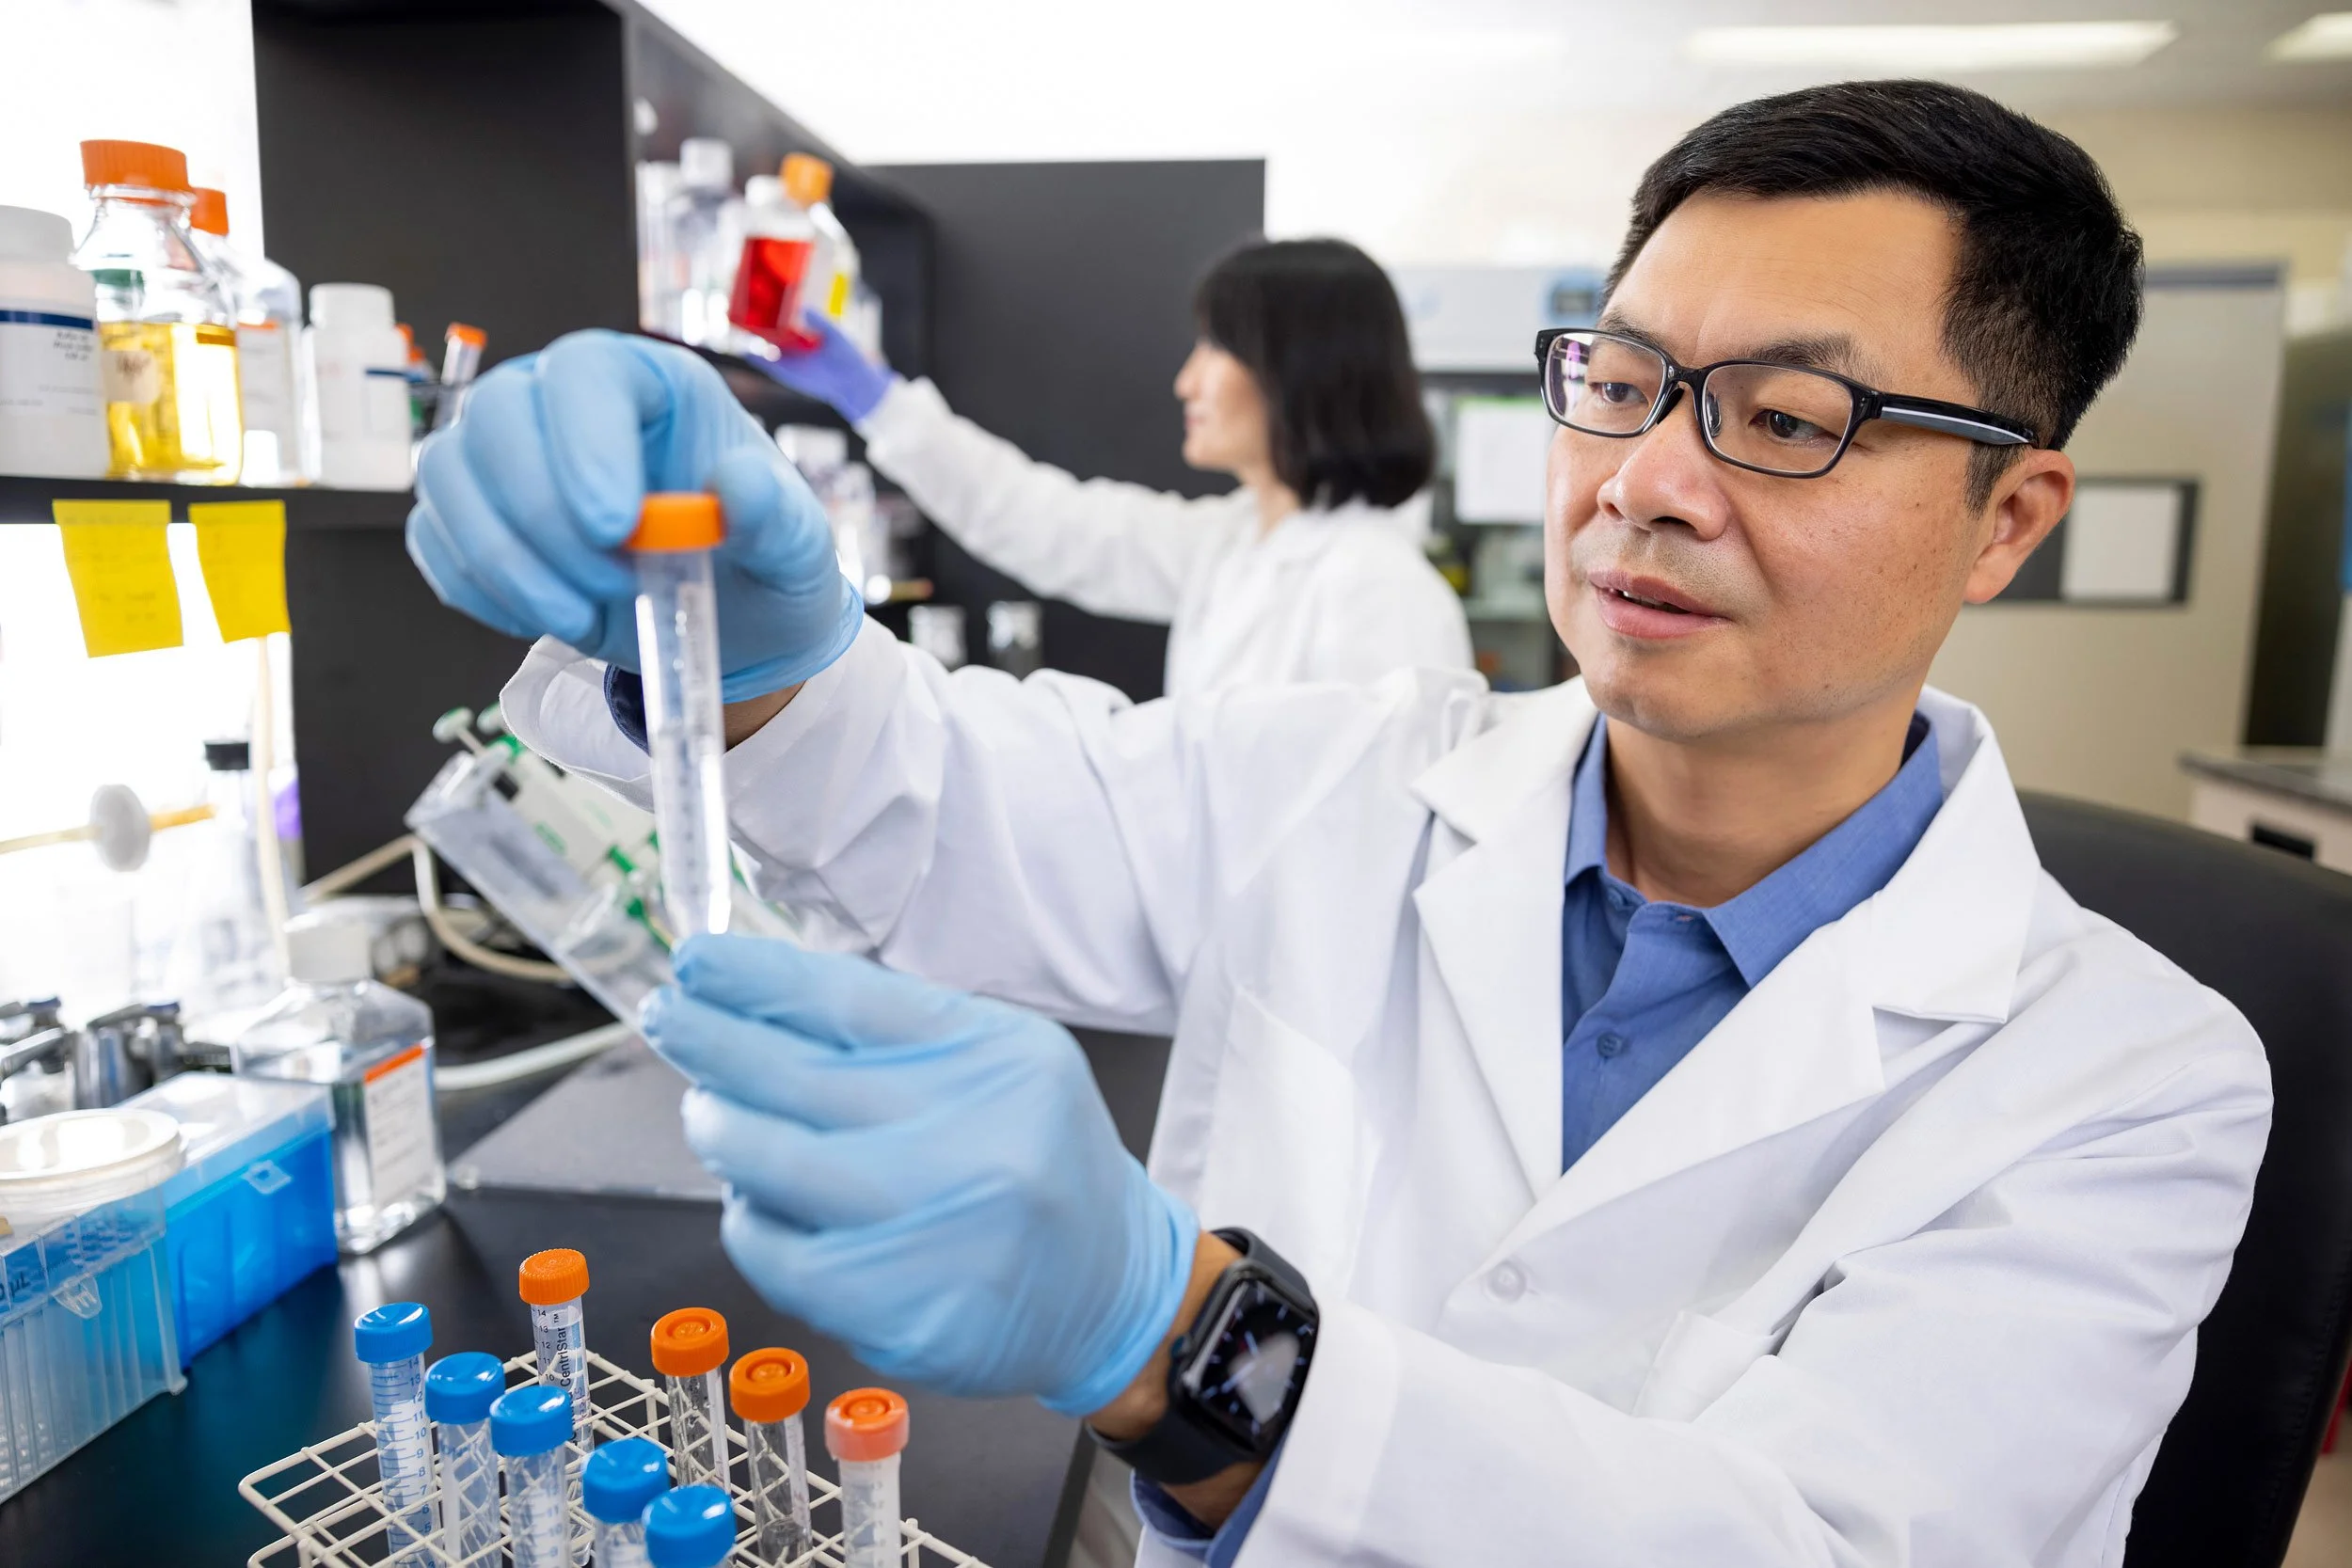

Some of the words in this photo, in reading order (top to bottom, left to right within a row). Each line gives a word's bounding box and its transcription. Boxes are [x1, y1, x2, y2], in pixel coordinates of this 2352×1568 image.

[539, 1325, 548, 1334] 13
[408, 1354, 420, 1369] 14
[410, 1373, 421, 1386] 13
[546, 1373, 555, 1382] 10
[413, 1391, 422, 1403] 12
[414, 1411, 423, 1421] 11
[416, 1427, 426, 1440] 10
[417, 1448, 424, 1459] 9
[419, 1466, 426, 1477] 8
[420, 1484, 428, 1496] 7
[421, 1503, 430, 1513] 6
[424, 1521, 432, 1533] 5
